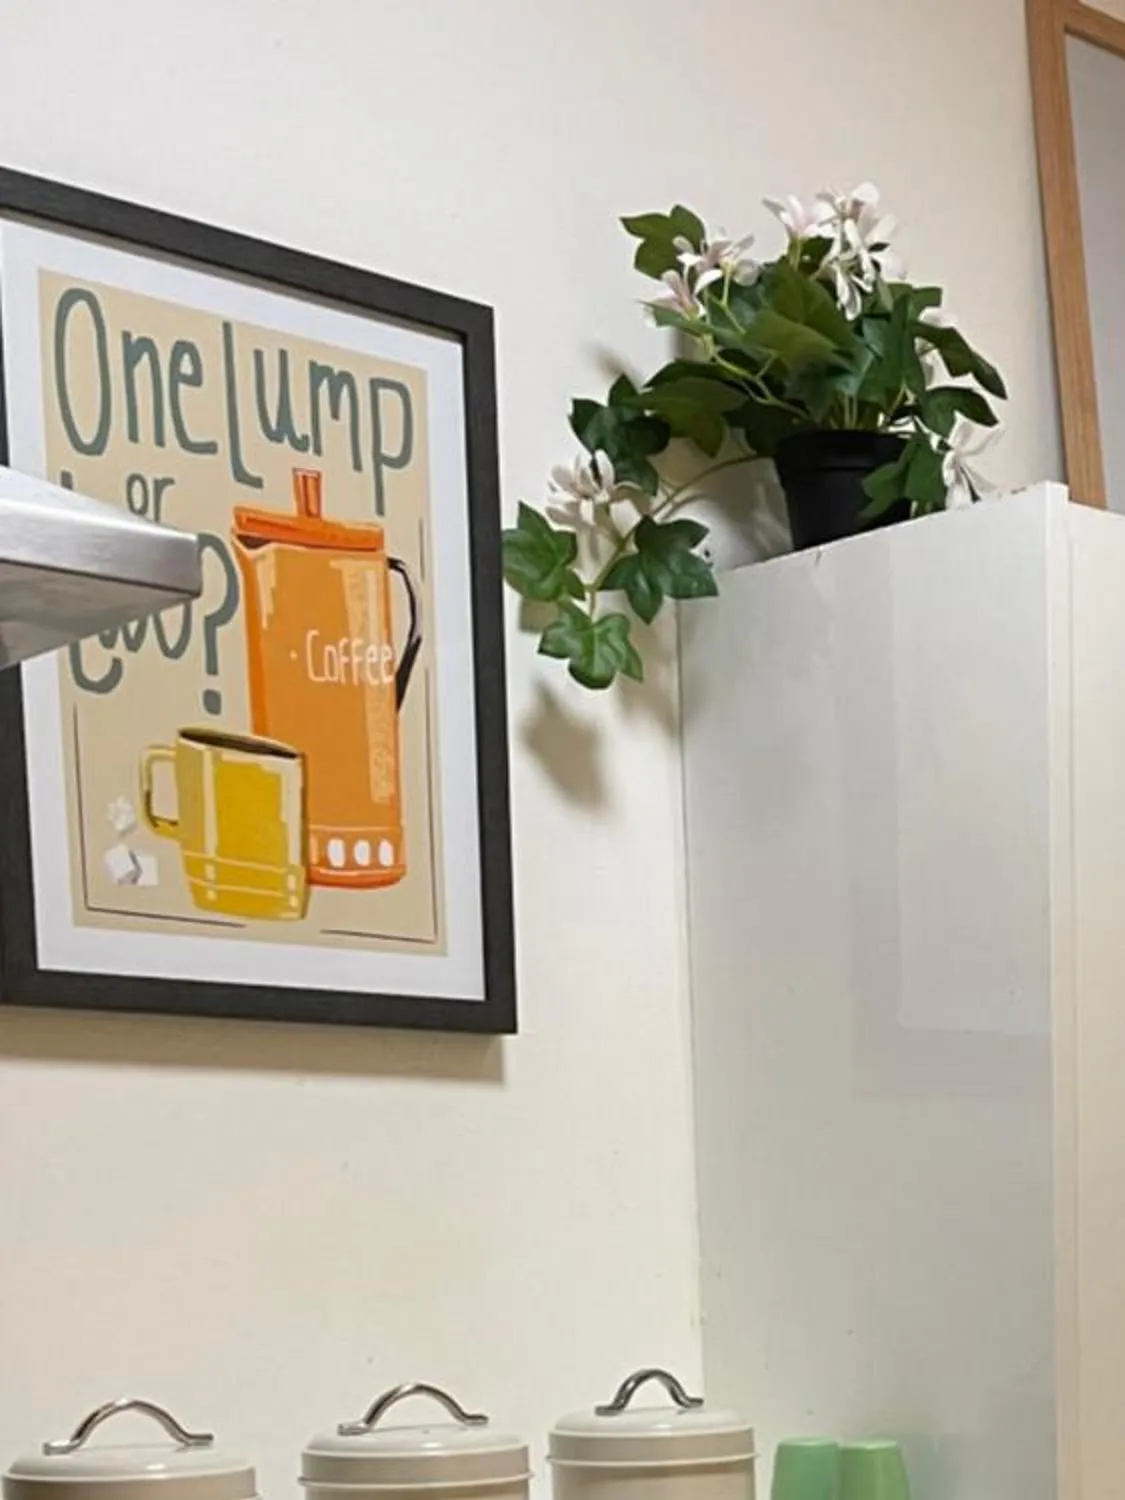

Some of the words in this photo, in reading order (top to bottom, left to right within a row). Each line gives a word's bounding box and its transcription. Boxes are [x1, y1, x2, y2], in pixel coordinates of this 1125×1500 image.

[54, 287, 218, 457] One
[126, 473, 175, 523] or
[305, 629, 396, 686] Coffee
